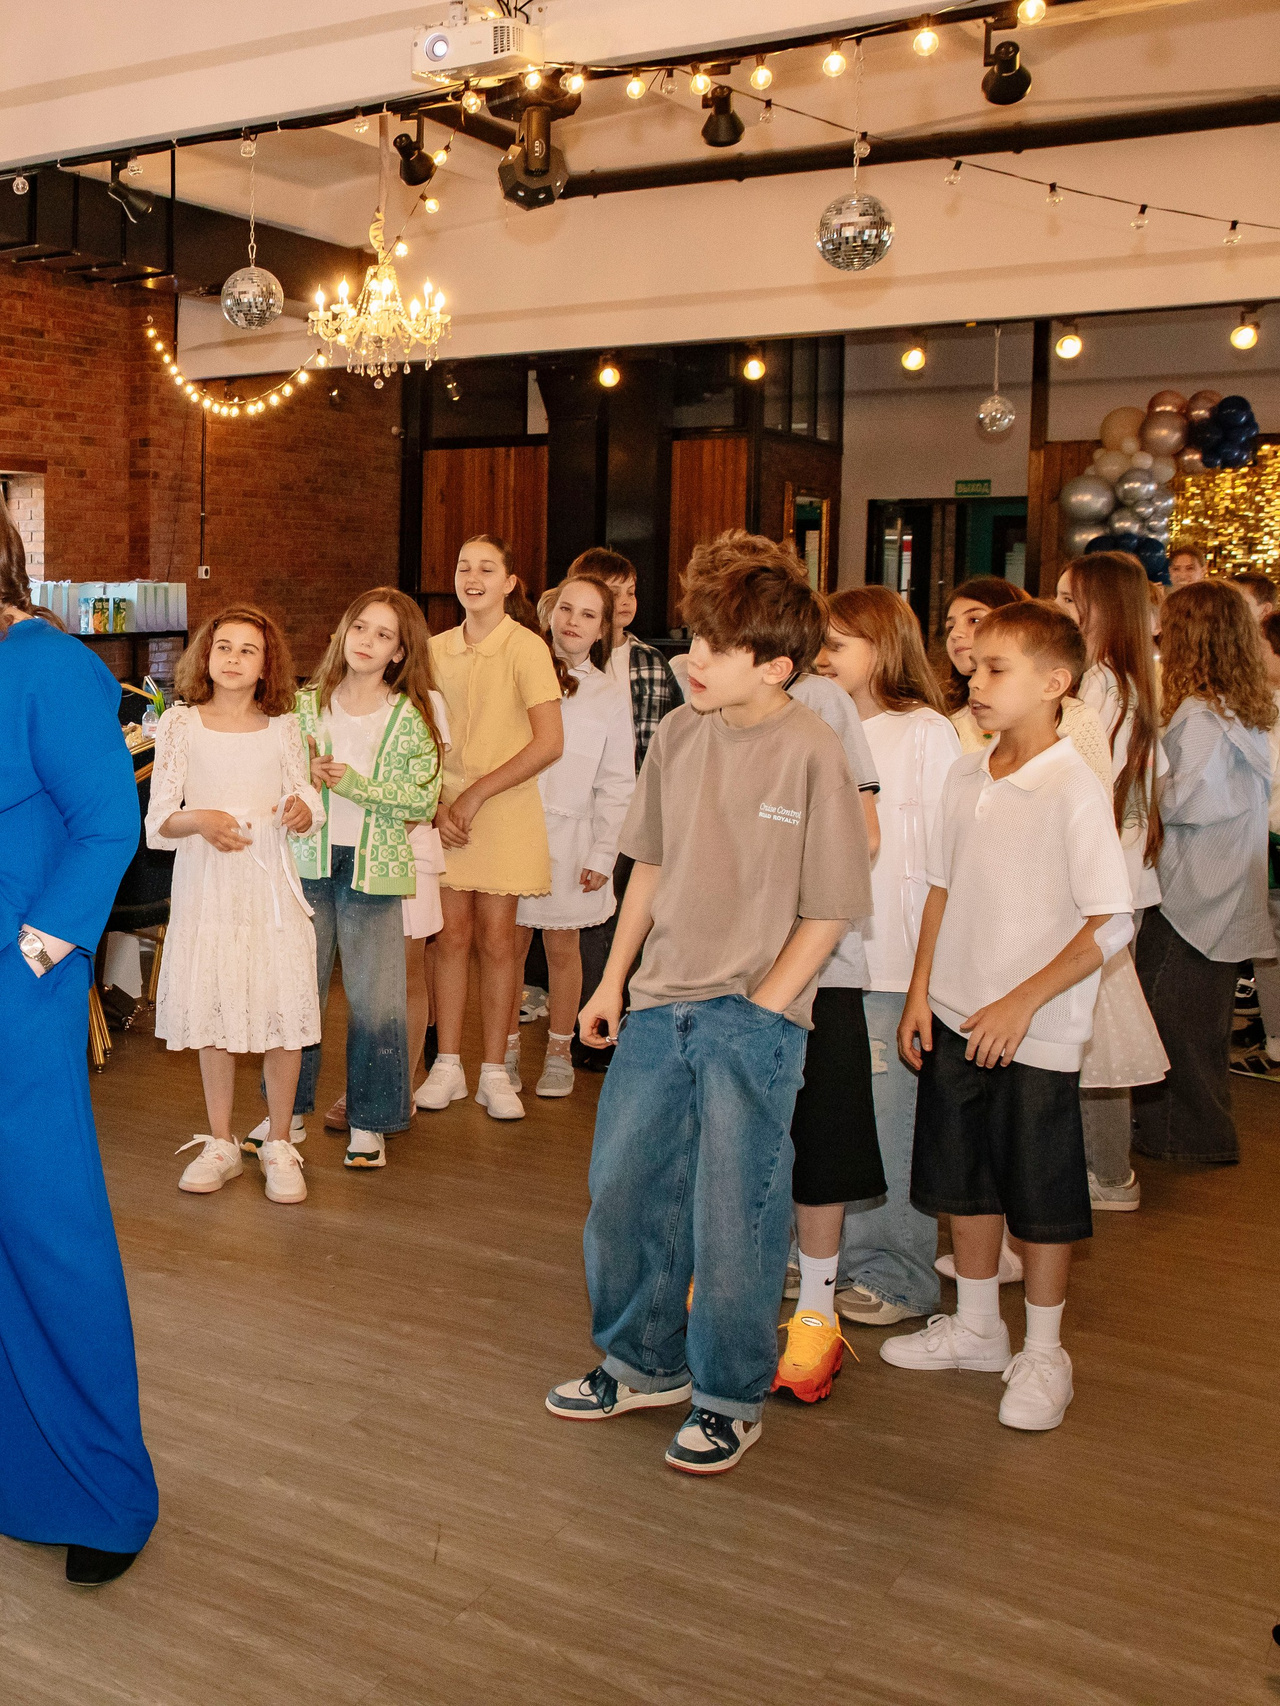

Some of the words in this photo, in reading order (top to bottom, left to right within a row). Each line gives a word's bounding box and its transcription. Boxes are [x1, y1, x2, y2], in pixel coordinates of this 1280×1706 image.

[957, 483, 989, 493] ВЫХОД
[760, 802, 776, 813] Cruise
[777, 806, 802, 819] Control
[772, 815, 800, 825] ROYALTY
